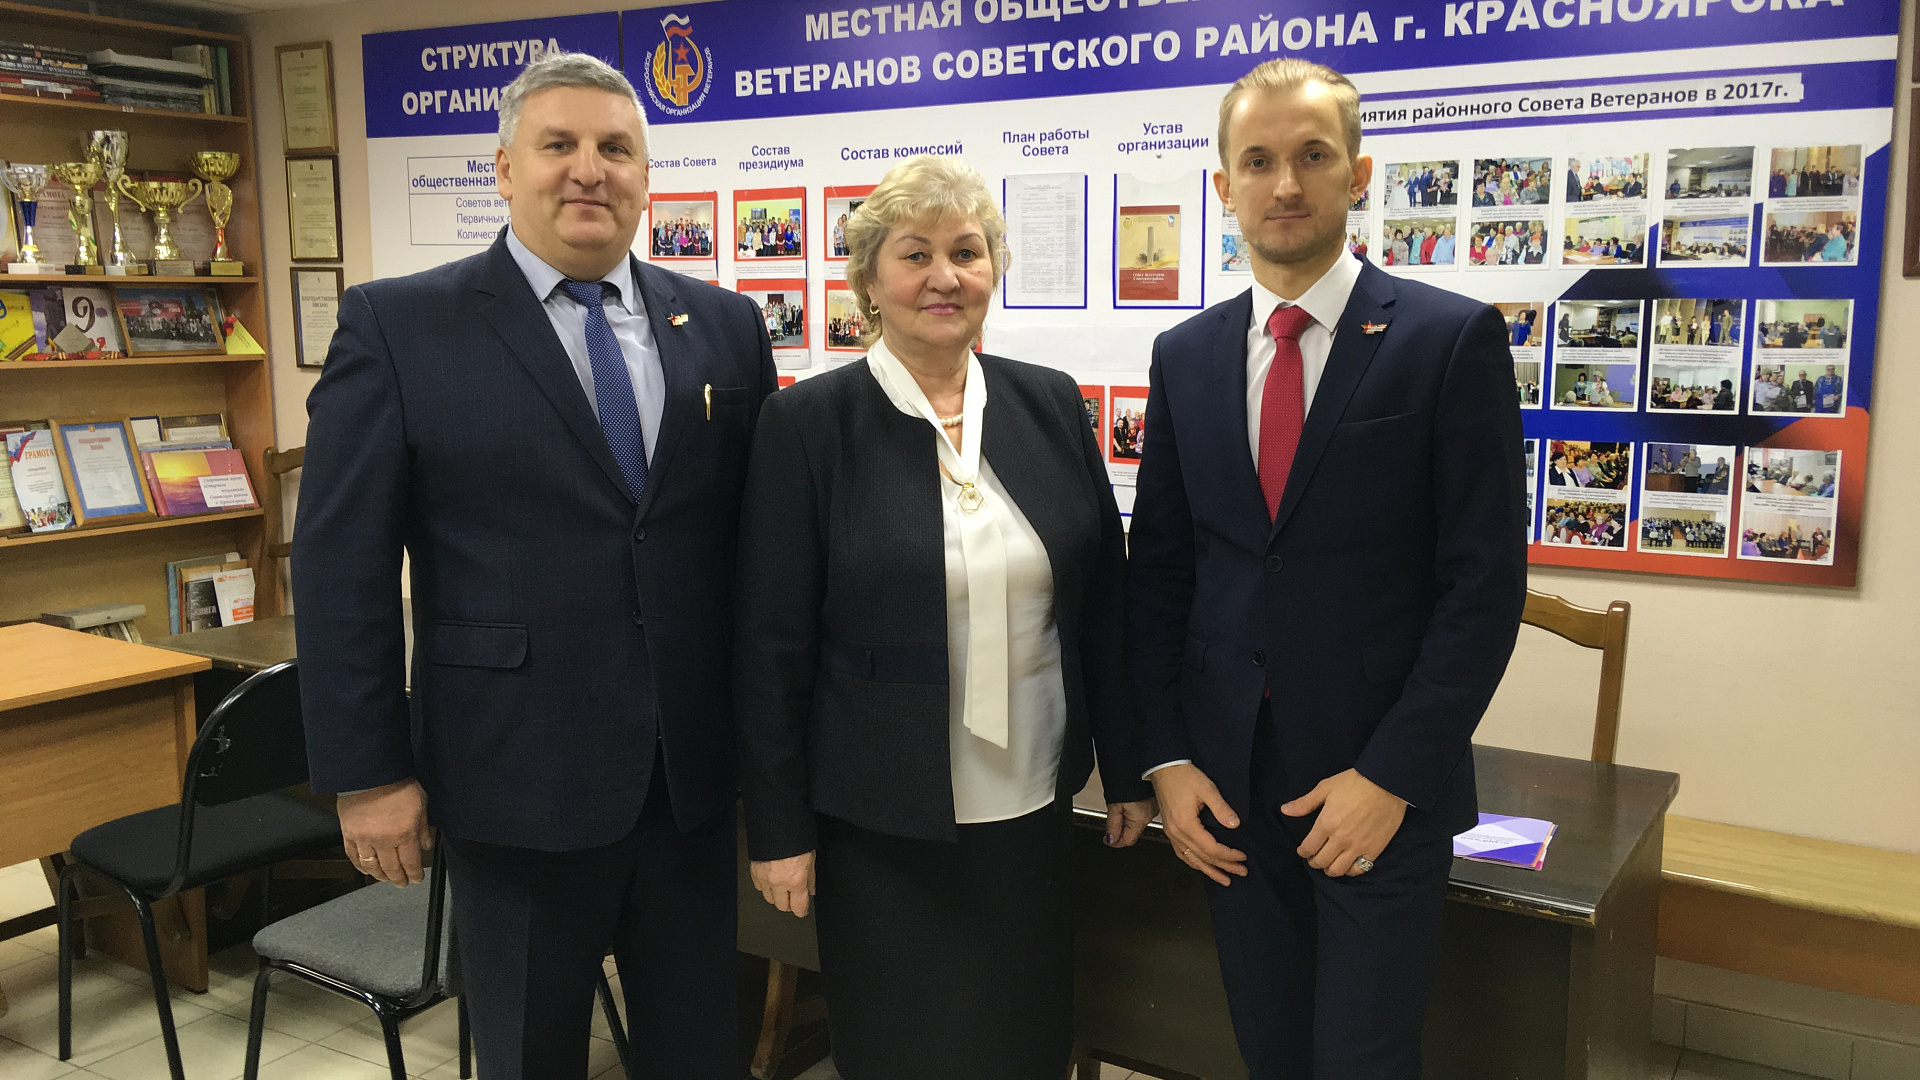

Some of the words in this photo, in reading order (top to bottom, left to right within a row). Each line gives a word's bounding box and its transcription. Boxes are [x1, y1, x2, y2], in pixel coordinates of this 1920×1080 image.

[805, 0, 962, 42] МЕСТНАЯ
[421, 38, 562, 72] СТРУКТУРА
[735, 55, 921, 97] ВЕТЕРАНОВ
[932, 31, 1181, 81] СОВЕТСКОГО
[1195, 12, 1378, 59] РАЙОНА
[1394, 15, 1426, 41] г.
[644, 51, 665, 113] ВСЕРОССИЙСКАЯ
[665, 93, 706, 116] ОРГАНИЗАЦИЯ
[703, 46, 714, 95] ВЕТЕРАНОВ
[402, 86, 505, 116] ОРГАНИ
[1412, 99, 1512, 122] районного
[1518, 94, 1584, 113] Совета
[1590, 88, 1698, 108] Ветеранов
[1705, 90, 1716, 101] в
[1723, 82, 1789, 100] 2017г.
[1003, 131, 1035, 144] План
[1039, 128, 1090, 144] работы
[1143, 123, 1183, 136] Устав
[751, 145, 790, 157] Состав
[841, 146, 890, 161] Состав
[894, 140, 963, 158] комиссий
[1022, 145, 1069, 157] Совета
[1117, 138, 1209, 154] организации
[467, 160, 496, 173] Мест
[648, 158, 680, 169] Состав
[683, 156, 717, 168] Совета
[739, 157, 804, 171] президиума
[412, 175, 496, 189] общественная
[456, 197, 491, 208] Советов
[457, 213, 504, 226] Первичных
[457, 229, 499, 239] Количест
[25, 448, 55, 460] ГРАМОТА
